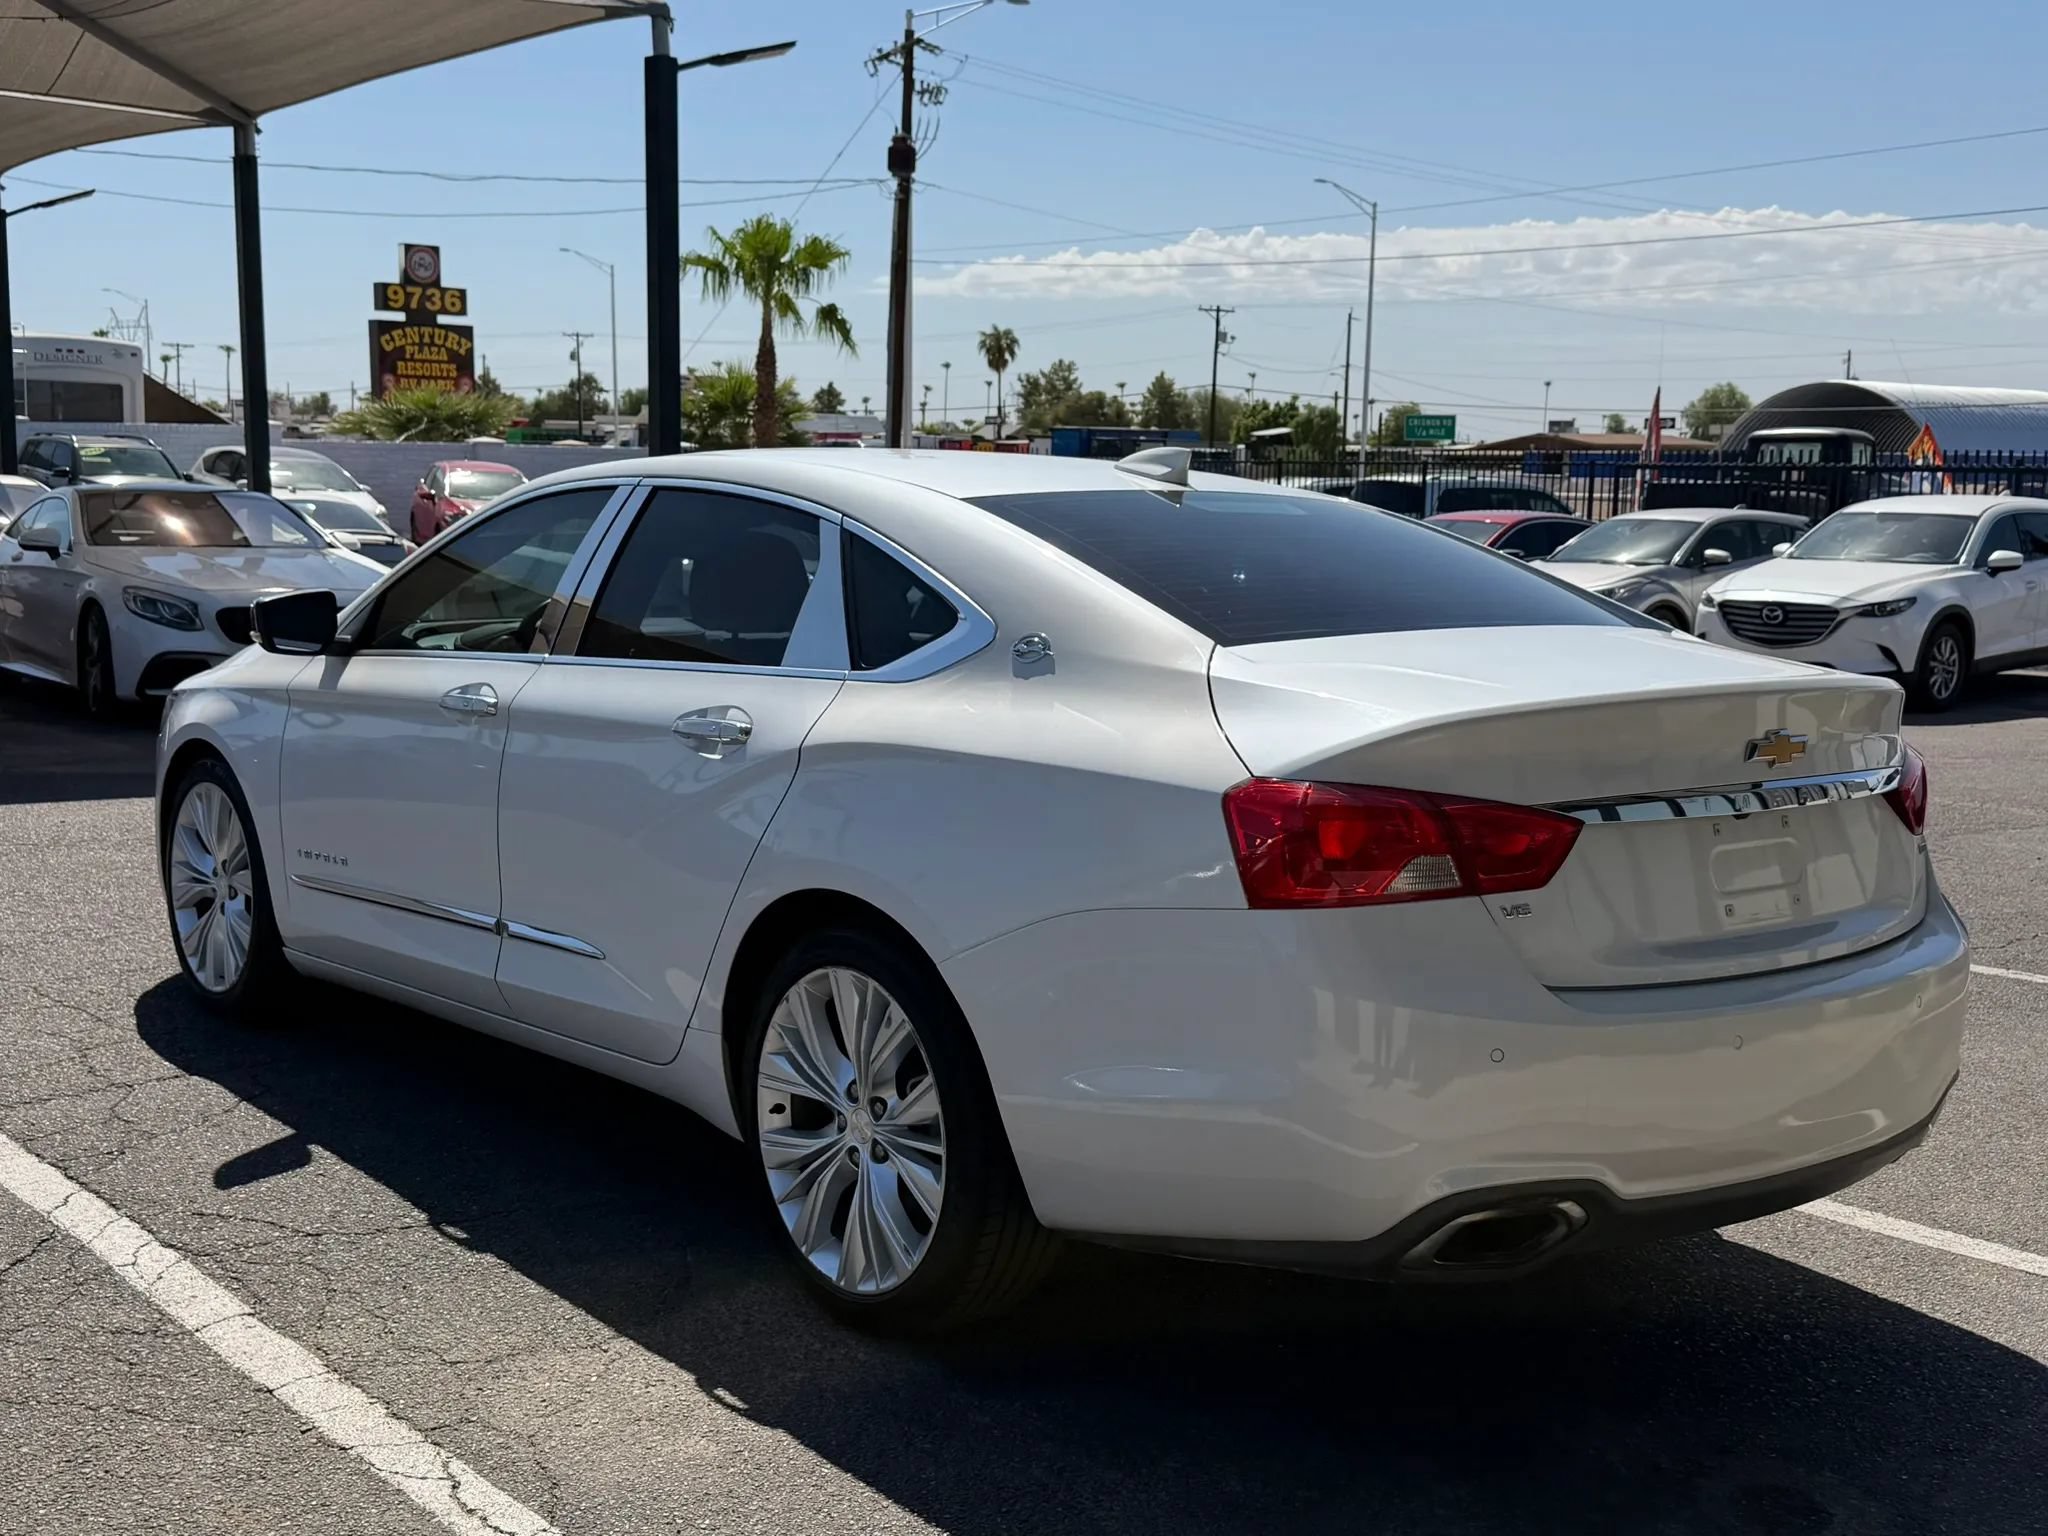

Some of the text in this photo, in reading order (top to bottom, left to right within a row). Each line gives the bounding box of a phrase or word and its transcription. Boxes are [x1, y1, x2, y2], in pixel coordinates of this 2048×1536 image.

[386, 285, 462, 313] 9736
[380, 327, 472, 356] CENTURY
[33, 352, 104, 364] DESIGNER
[405, 345, 448, 360] PLAZA
[396, 361, 457, 376] RESORTS
[399, 377, 455, 392] RV PARK
[1500, 902, 1533, 919] V6
